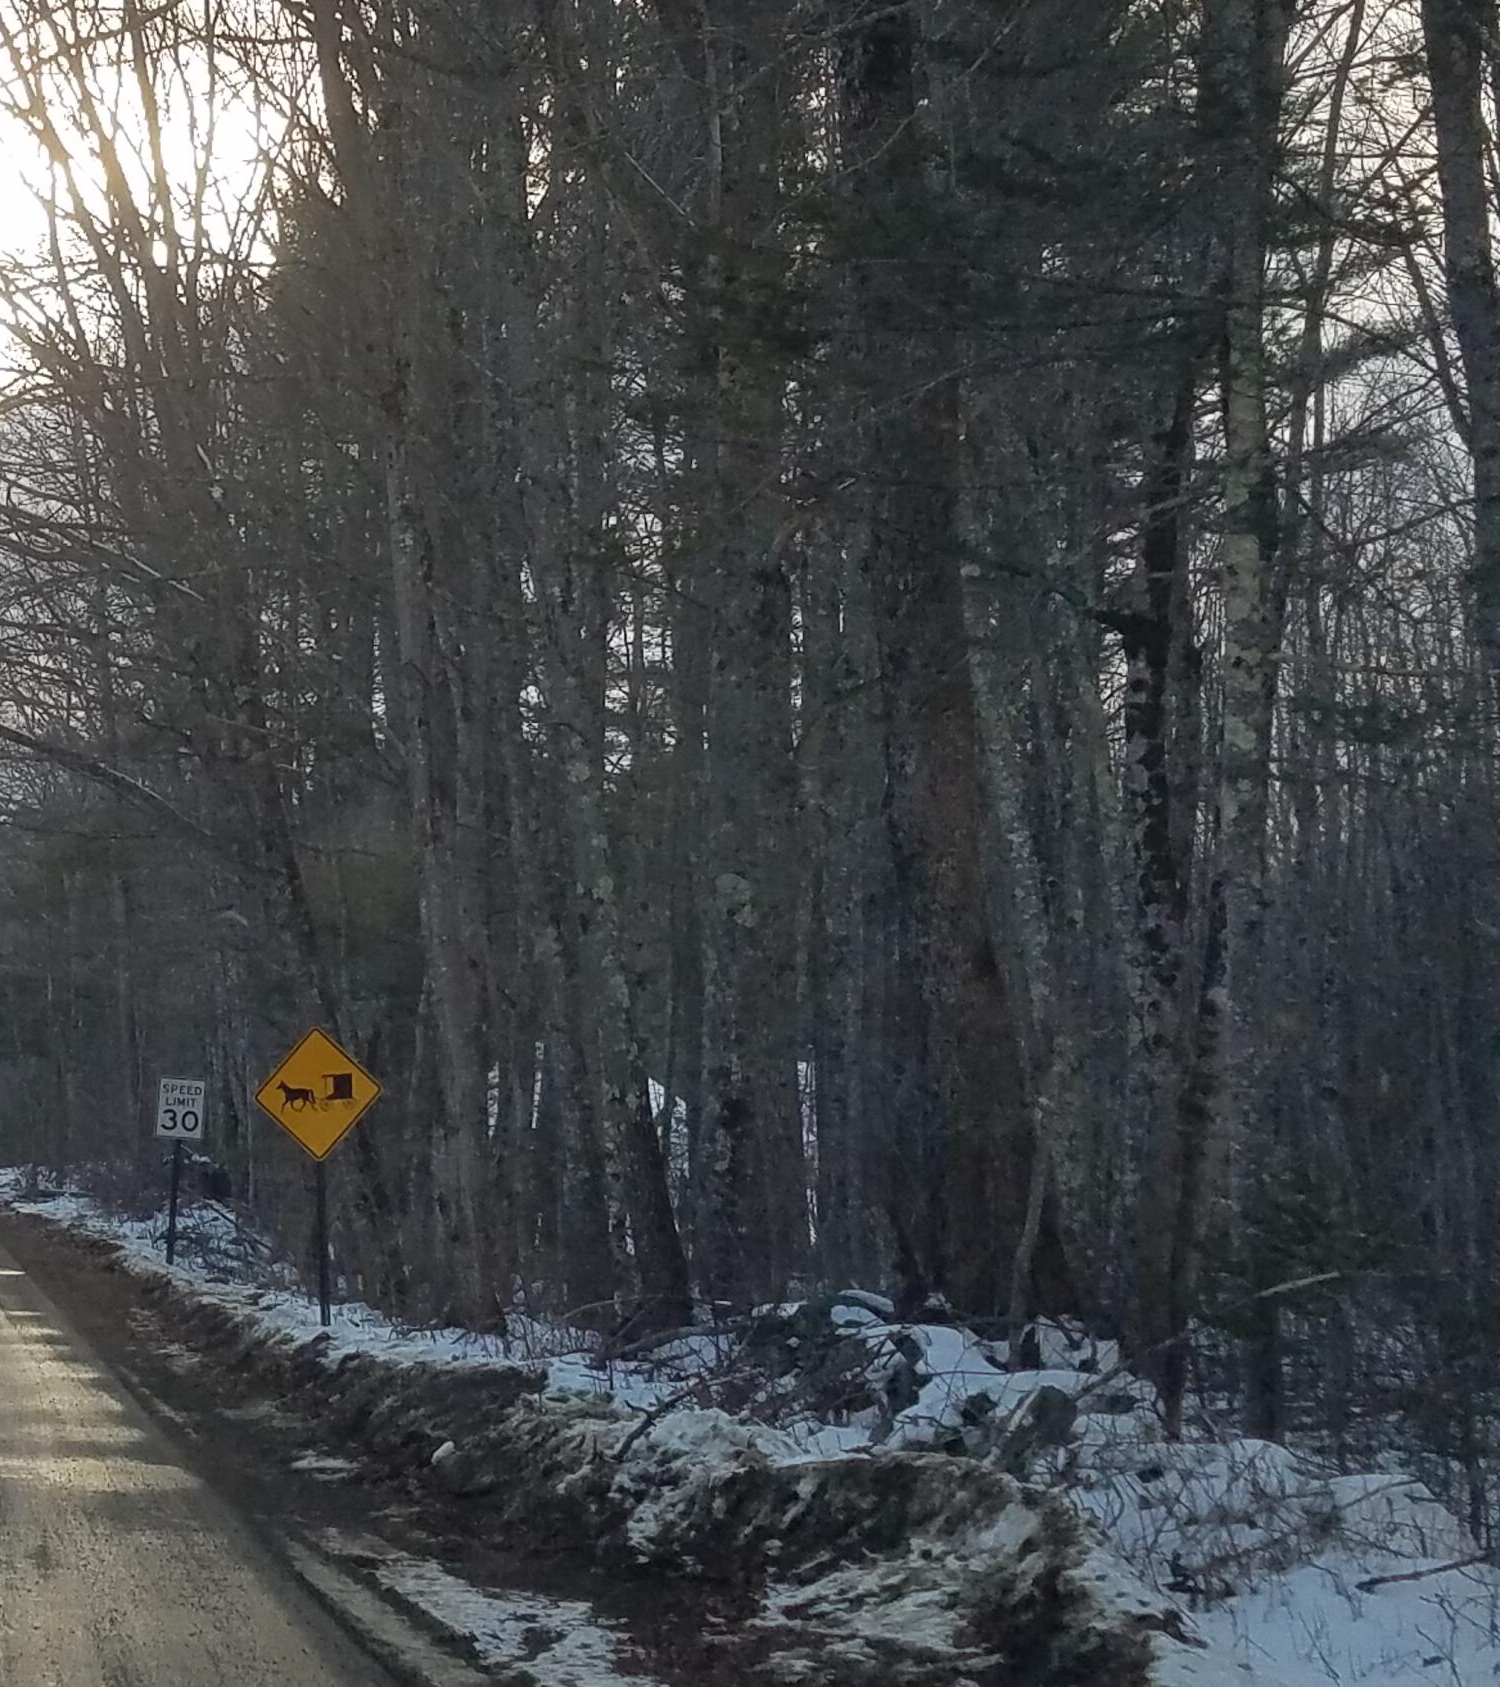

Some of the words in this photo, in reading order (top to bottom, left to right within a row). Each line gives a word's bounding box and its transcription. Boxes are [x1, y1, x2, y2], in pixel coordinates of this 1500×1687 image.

[163, 1083, 203, 1096] SPEED
[165, 1096, 196, 1108] LIMIT
[161, 1108, 199, 1132] 30
